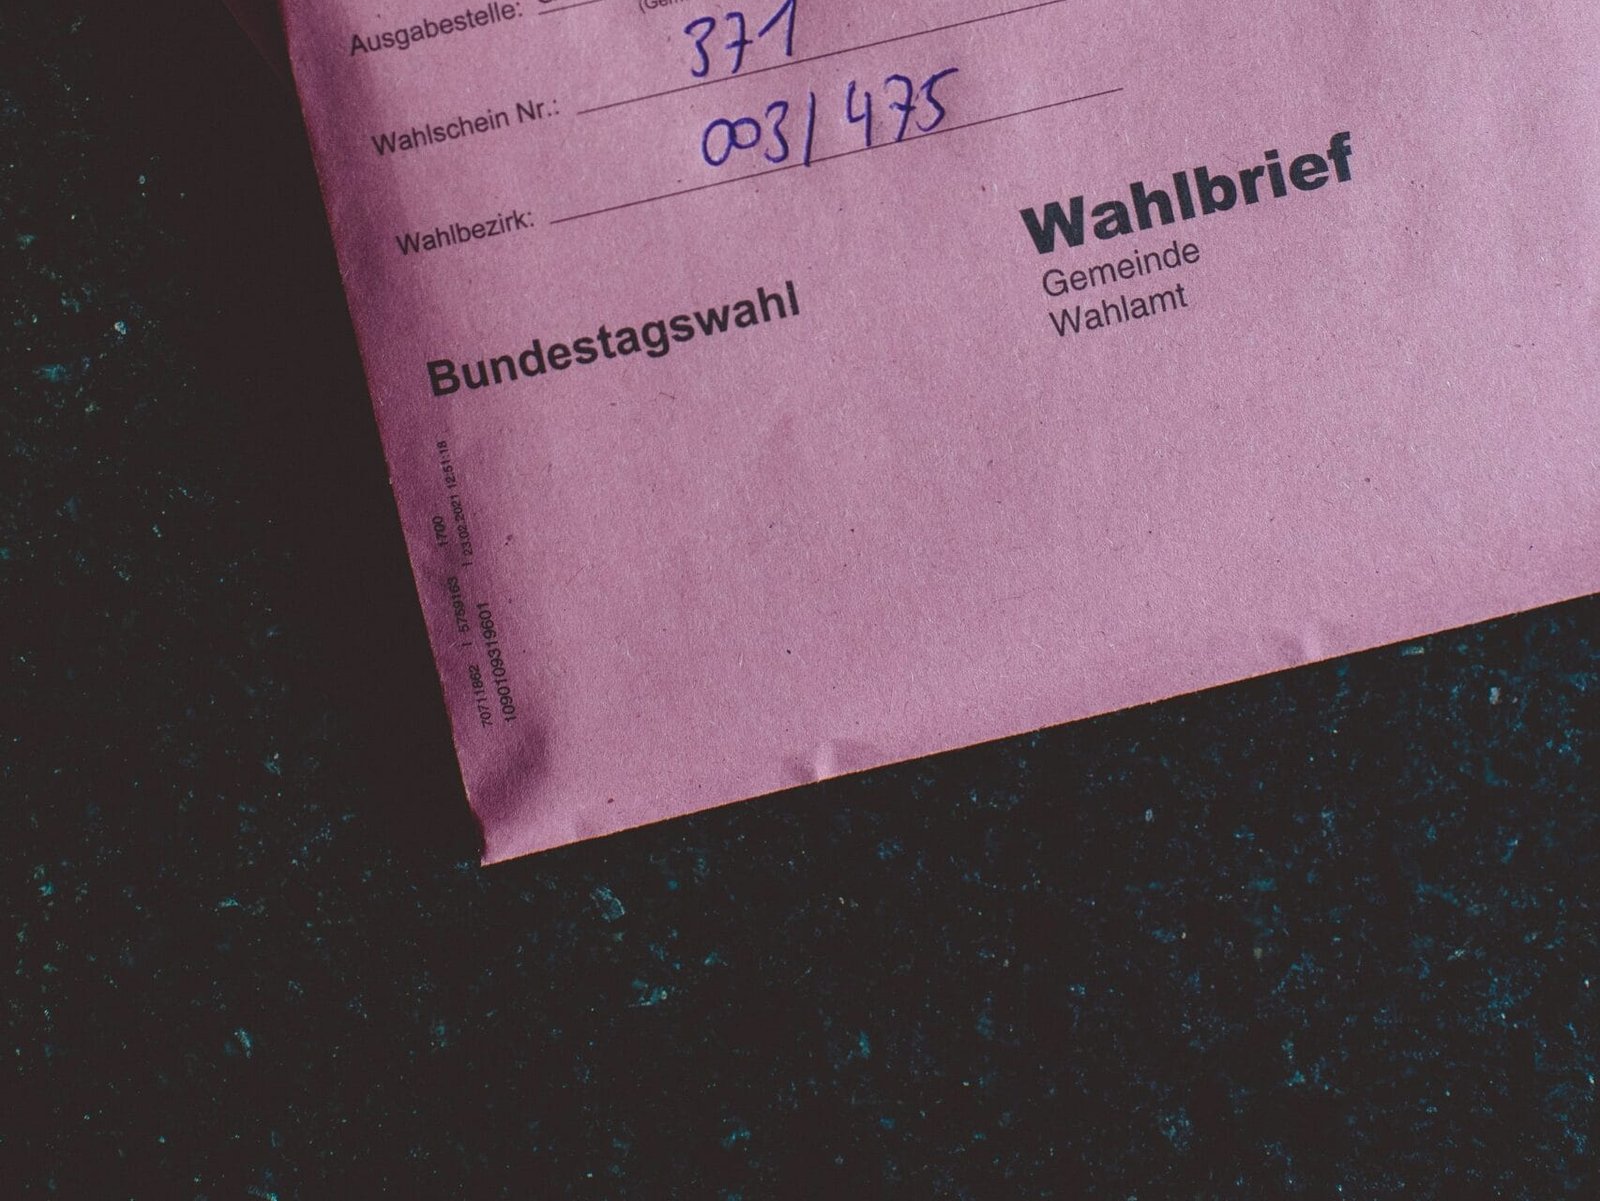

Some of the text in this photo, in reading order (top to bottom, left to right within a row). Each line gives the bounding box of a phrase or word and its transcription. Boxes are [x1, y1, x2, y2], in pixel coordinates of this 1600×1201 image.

[350, 0, 523, 56] Ausgabestelle:
[371, 99, 560, 156] Wahlschein Nr.:
[1019, 131, 1353, 254] Wahlbrief
[395, 209, 535, 256] Wahlbezirk:
[1042, 240, 1201, 297] Gemeinde
[426, 280, 800, 397] Bundestagswahl
[1048, 283, 1188, 337] Wahlamt
[437, 440, 456, 489] 12:51:18
[450, 494, 473, 556] 23.02.2021
[447, 576, 470, 634] 5759163
[475, 602, 518, 723] 1090109319601
[468, 663, 494, 728] 70711862
